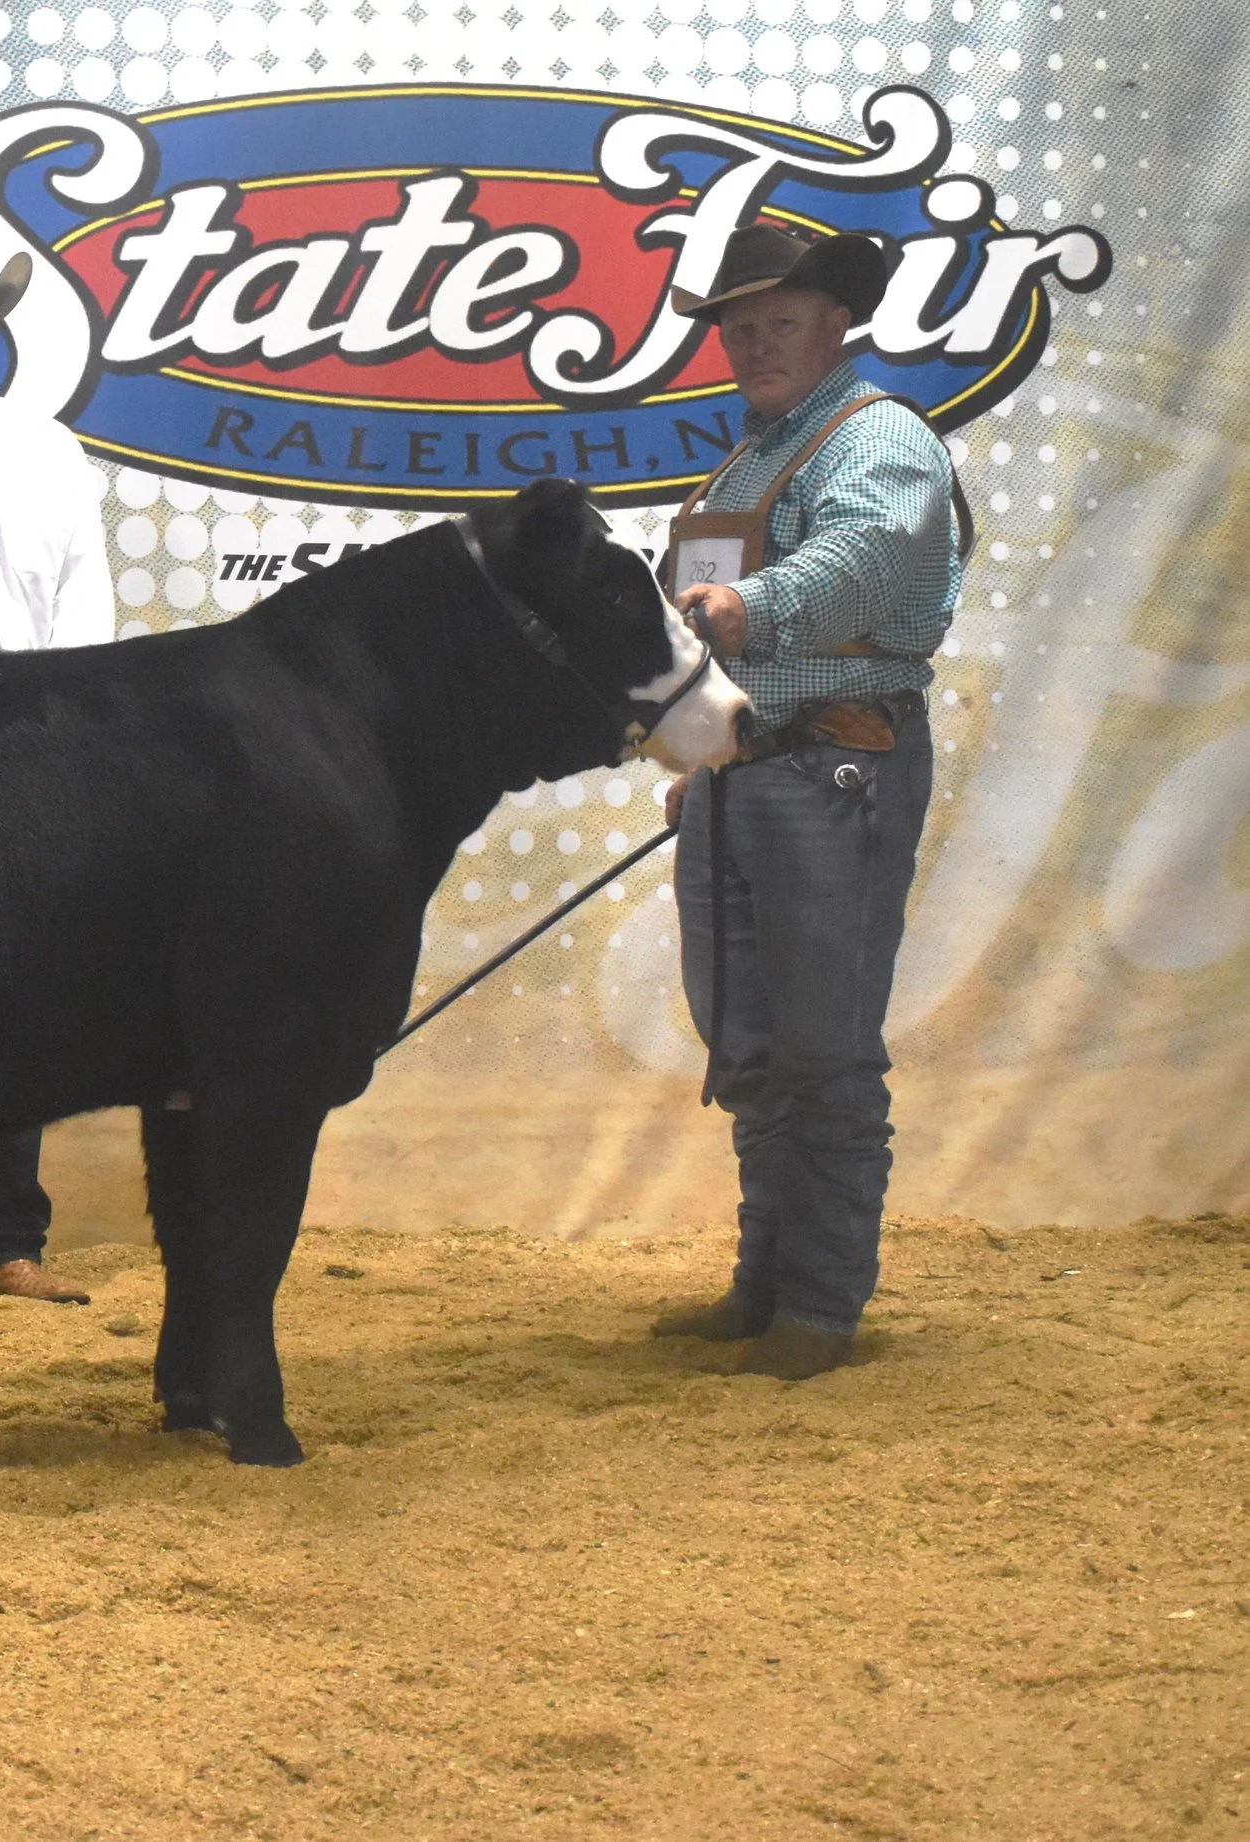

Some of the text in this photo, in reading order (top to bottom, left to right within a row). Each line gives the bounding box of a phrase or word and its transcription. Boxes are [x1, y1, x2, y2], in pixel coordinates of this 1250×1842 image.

[529, 90, 1100, 394] Fir
[219, 554, 287, 581] THE
[689, 560, 717, 584] 262
